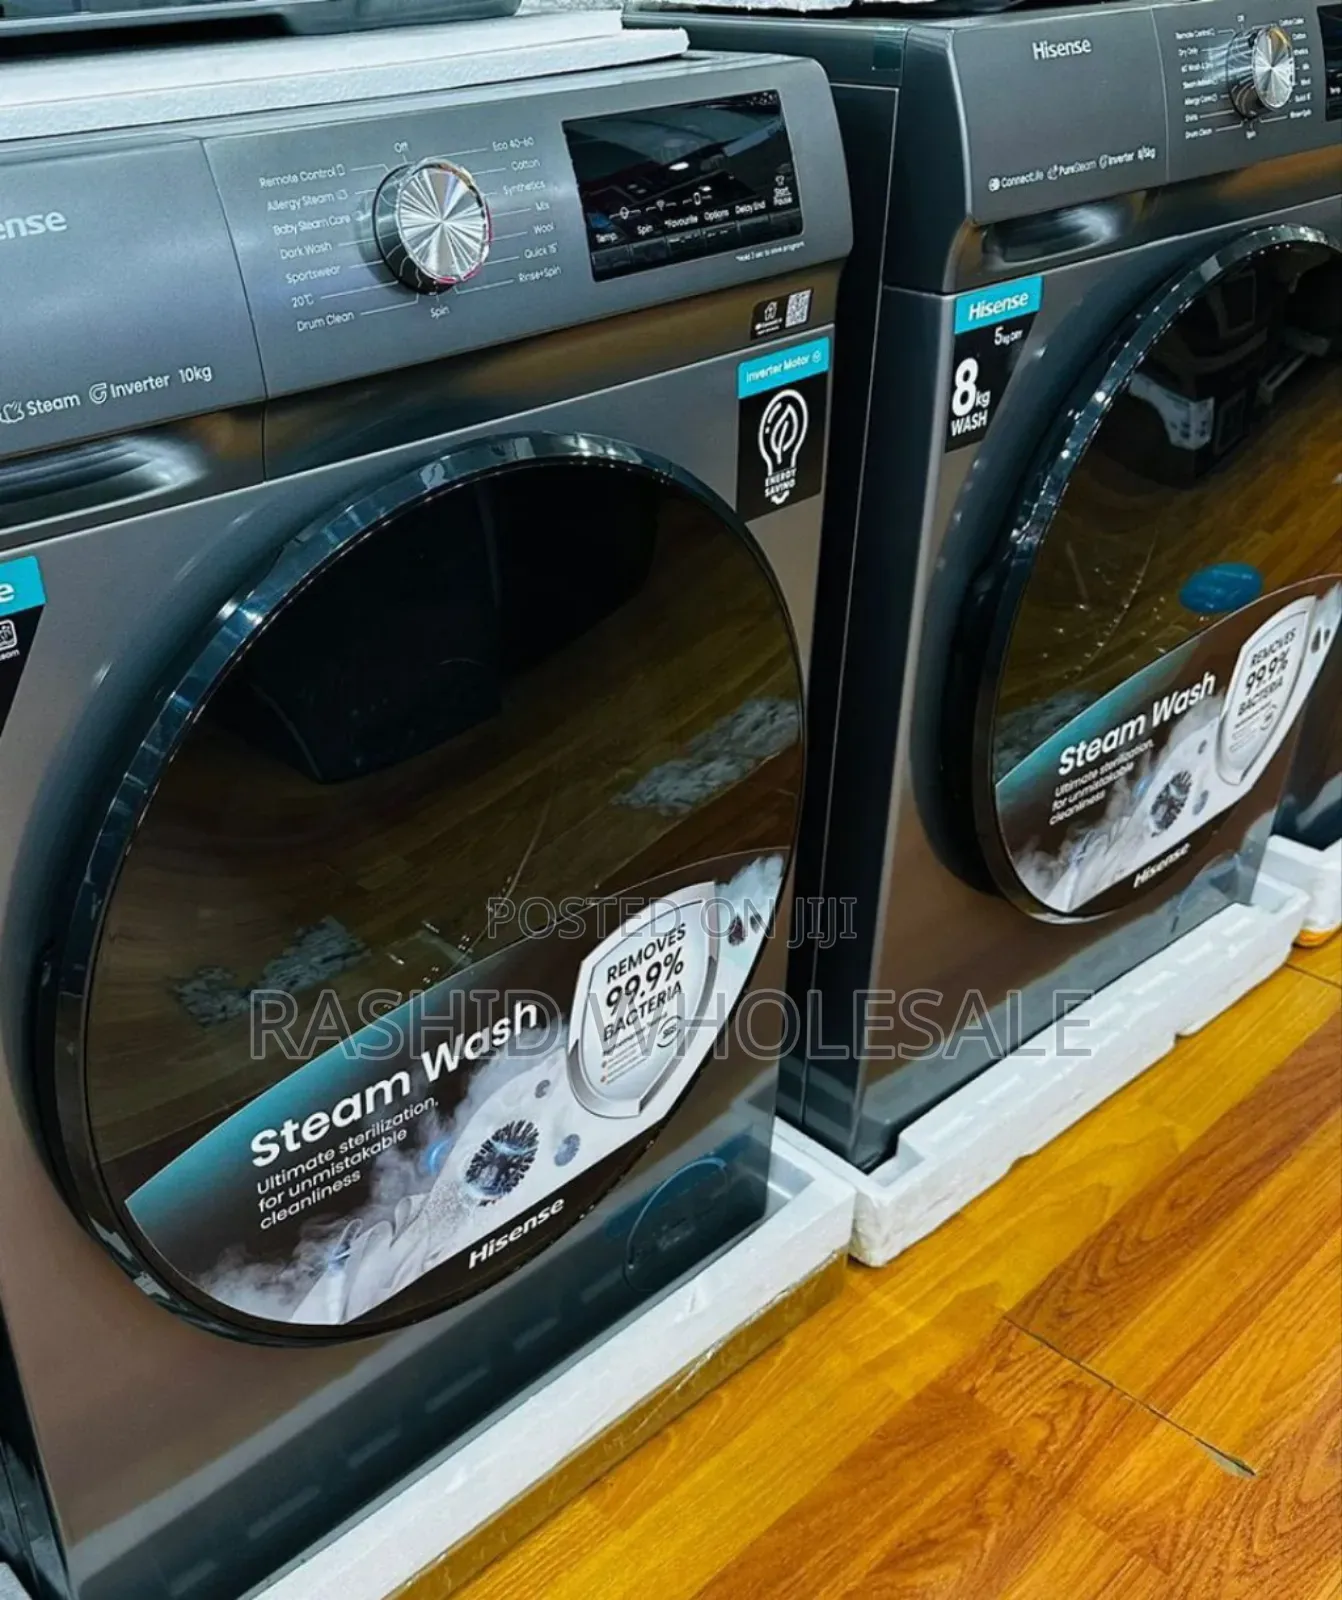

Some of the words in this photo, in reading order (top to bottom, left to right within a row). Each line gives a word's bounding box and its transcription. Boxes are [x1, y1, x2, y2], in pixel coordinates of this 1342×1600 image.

[1032, 38, 1092, 60] Hisense
[394, 141, 409, 153] Off
[492, 141, 508, 152] Eco
[1108, 151, 1135, 166] Inverter
[259, 174, 298, 189] Remote
[299, 165, 337, 181] Control
[511, 158, 541, 172] Cotton
[503, 180, 546, 196] Synthetics
[267, 196, 300, 212] Allergy
[301, 193, 336, 208] Steam
[272, 222, 299, 237] Baby
[299, 217, 329, 234] Steam
[328, 213, 351, 228] Care
[533, 222, 555, 236] Wool
[637, 224, 654, 236] Spin
[704, 208, 730, 221] Options
[735, 203, 753, 215] Delay
[280, 246, 305, 261] Dark
[305, 242, 333, 256] Wash
[524, 247, 548, 259] Quick
[286, 264, 341, 286] Sportswear
[518, 265, 562, 283] Rinse+Spin
[430, 305, 450, 320] Spin
[968, 291, 1029, 322] Hisense
[297, 317, 326, 332] Drum
[326, 311, 355, 326] Clean
[746, 363, 783, 384] Inverter
[783, 354, 810, 371] Motor
[26, 393, 81, 416] Steam
[110, 373, 171, 399] Inverter
[178, 364, 213, 384] 10kg
[951, 409, 988, 437] WASH
[764, 467, 798, 488] ENERGY
[764, 479, 796, 498] SAVING
[1058, 713, 1147, 776] Steam
[1152, 671, 1217, 728] Wash
[1051, 797, 1069, 812] for
[1068, 761, 1135, 803] unmistakable
[1055, 769, 1099, 798] Ultimate
[1049, 789, 1107, 826] cleanliness
[1133, 842, 1191, 888] Hisense
[606, 922, 687, 985] REMOVES
[605, 946, 684, 1017] 99.9%
[603, 980, 683, 1042] BACTERIA
[250, 1070, 411, 1168] Steam
[420, 1000, 538, 1083] Wash
[256, 1148, 335, 1196] Ultimate
[258, 1190, 288, 1214] for
[289, 1128, 408, 1197] unmistakable
[260, 1169, 362, 1231] cleanliness
[468, 1197, 566, 1270] Hisense
